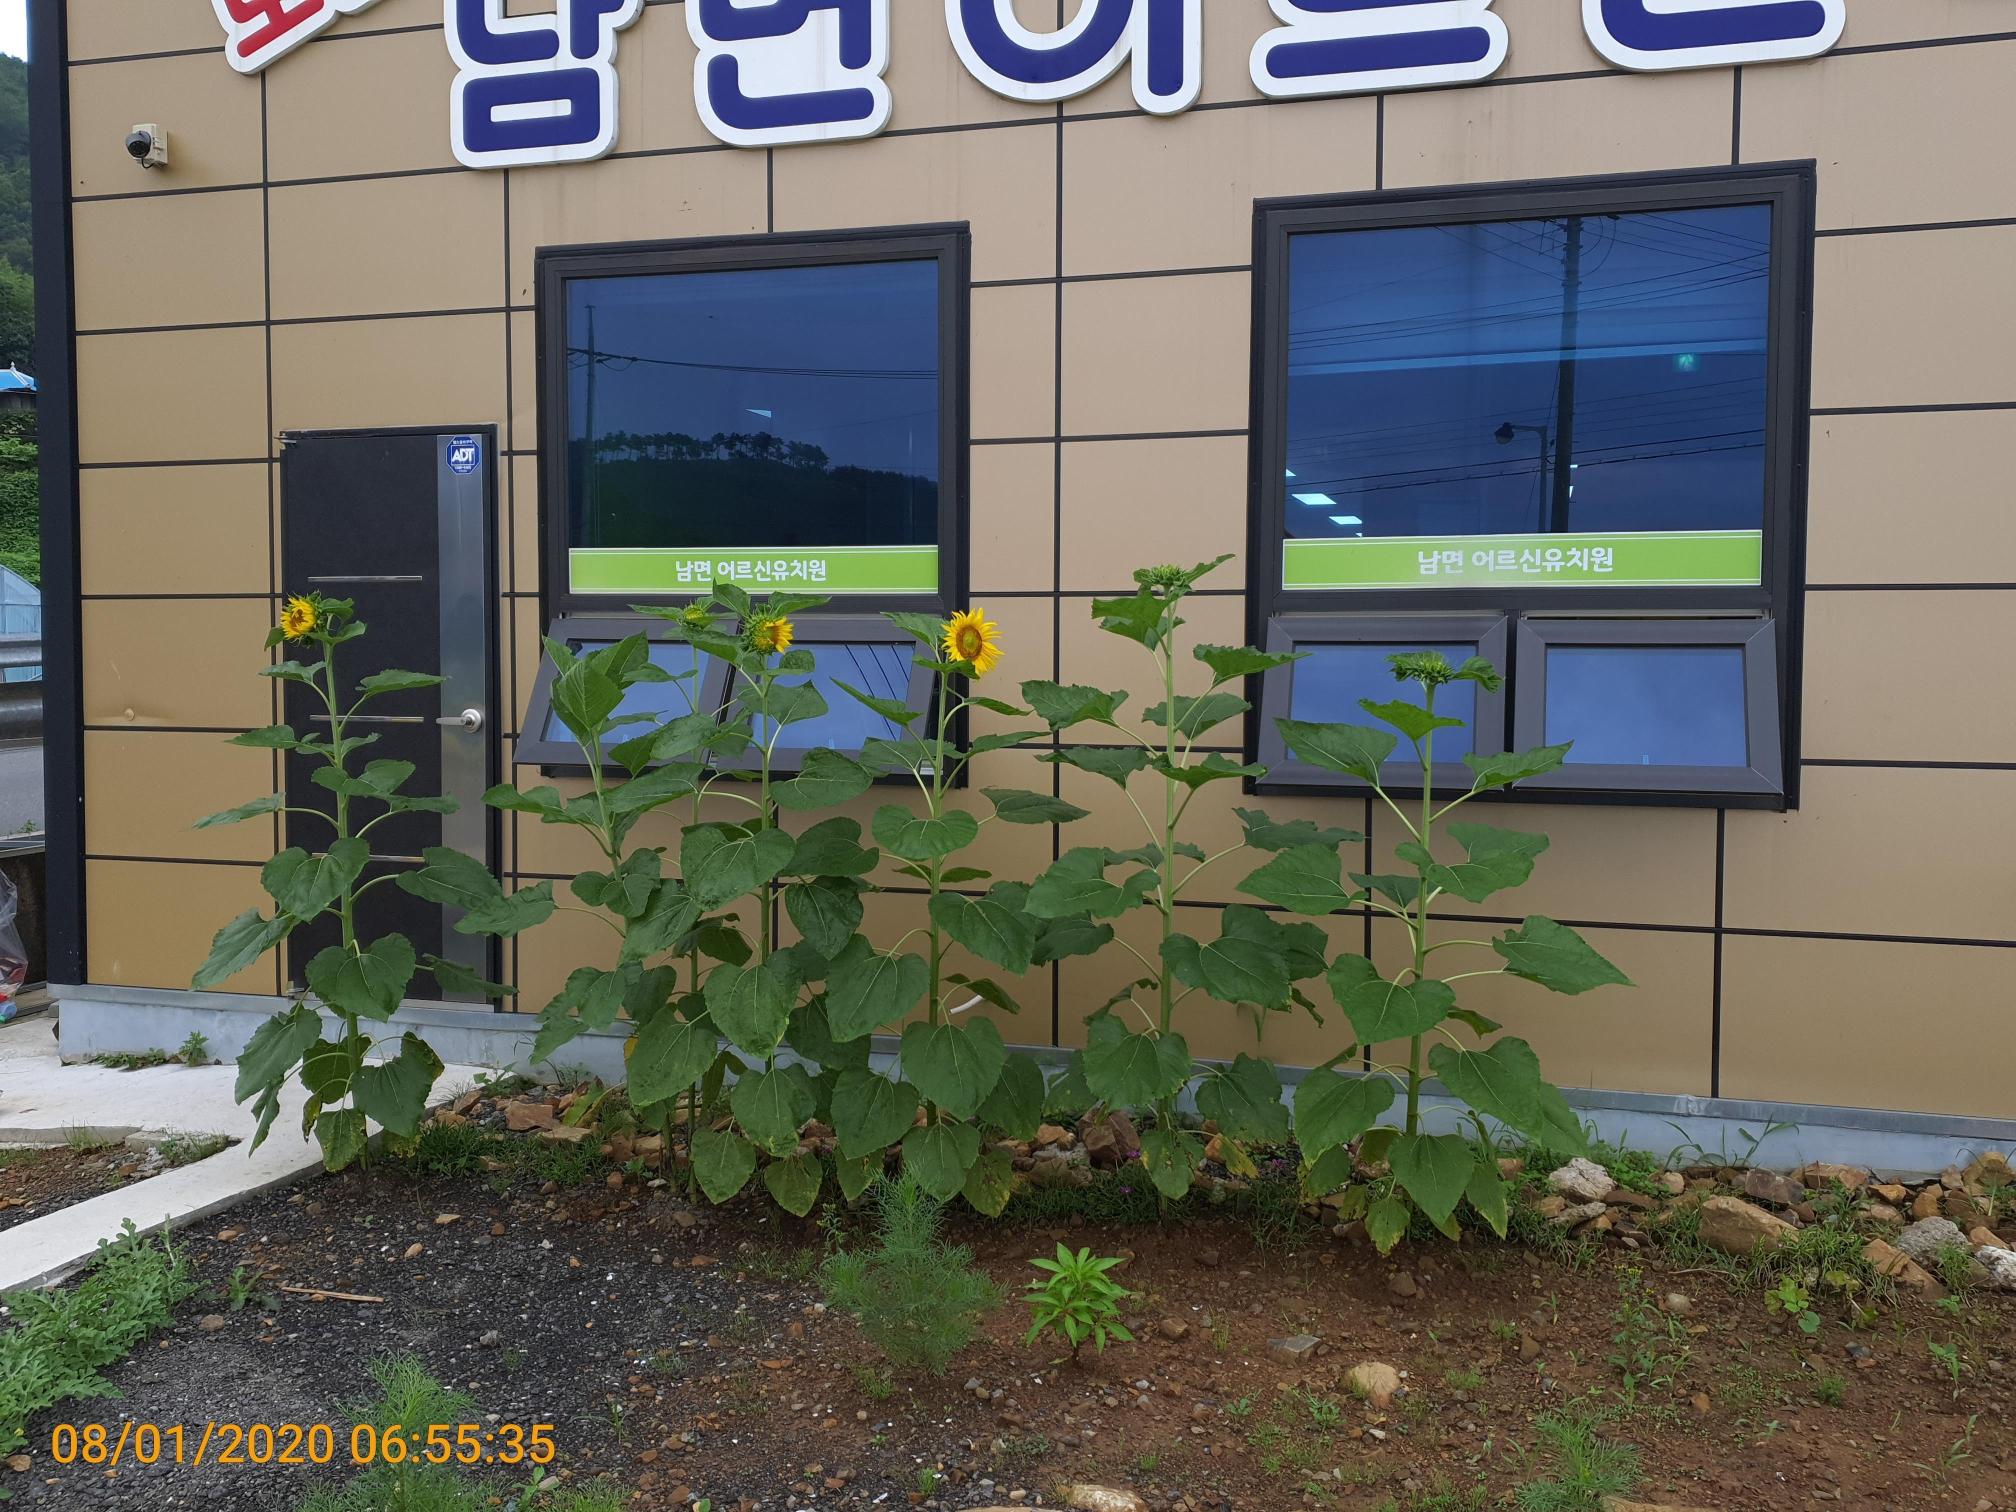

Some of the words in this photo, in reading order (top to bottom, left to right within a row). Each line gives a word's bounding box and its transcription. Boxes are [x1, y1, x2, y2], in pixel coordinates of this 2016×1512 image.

[452, 447, 475, 462] ADT
[675, 560, 712, 582] 남면
[717, 559, 827, 582] 어르신유치원
[1418, 550, 1464, 575] 남면
[1471, 547, 1614, 573] 어르신유치원
